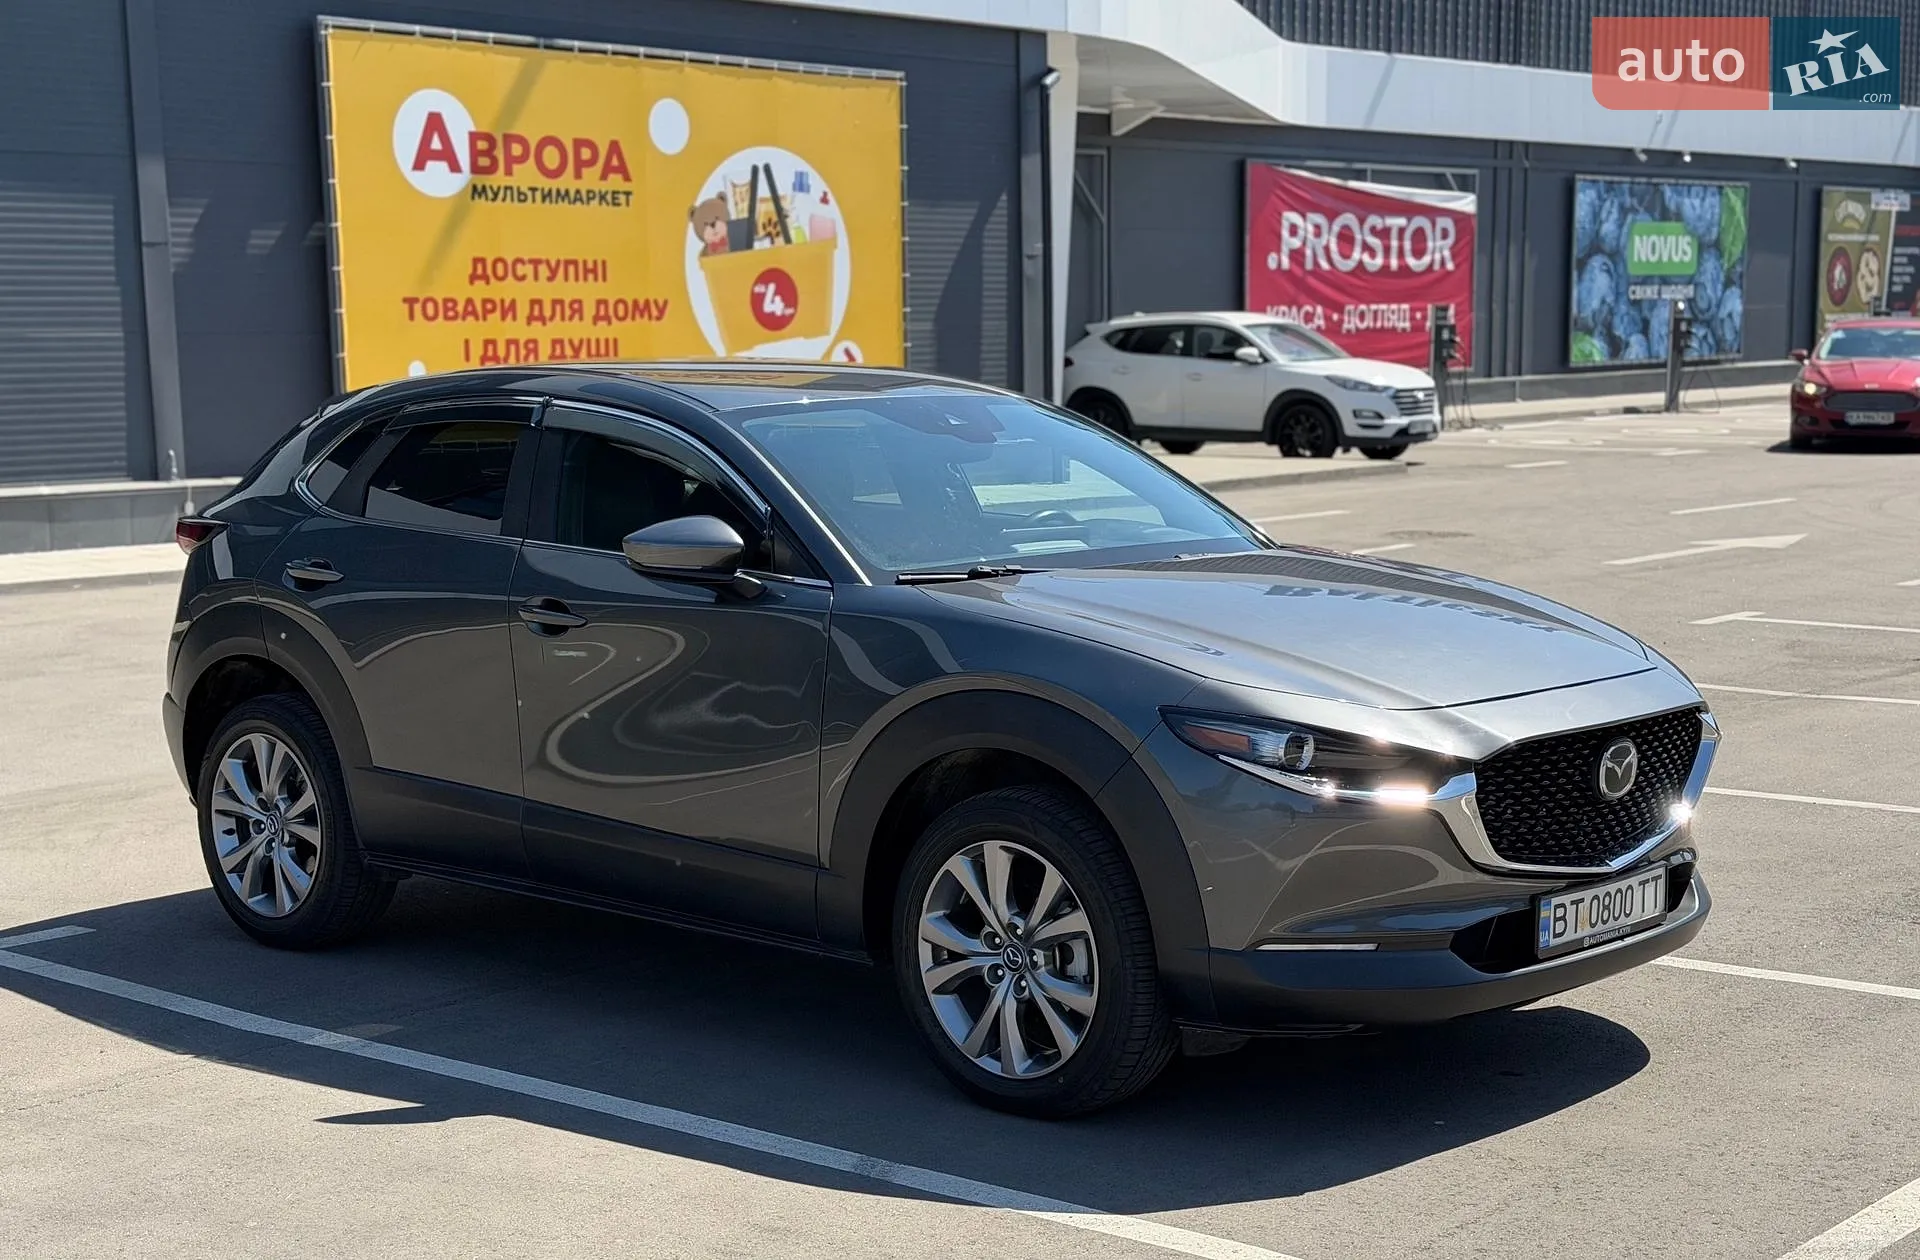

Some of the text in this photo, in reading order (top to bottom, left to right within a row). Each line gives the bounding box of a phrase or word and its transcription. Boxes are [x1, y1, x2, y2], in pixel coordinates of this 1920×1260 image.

[471, 183, 633, 208] МУЛЬТИМАРКЕТ
[1634, 234, 1693, 264] NOVUS
[468, 256, 608, 286] ДОСТУПНІ
[402, 297, 669, 326] ТОВАРИ ДЛЯ ДОМУ
[763, 282, 784, 317] 4
[1341, 304, 1411, 334] ДОГЛЯД
[464, 337, 619, 367] І ДЛЯ ДУШІ
[1552, 873, 1663, 939] BT 0800 TT
[1540, 930, 1549, 942] UA
